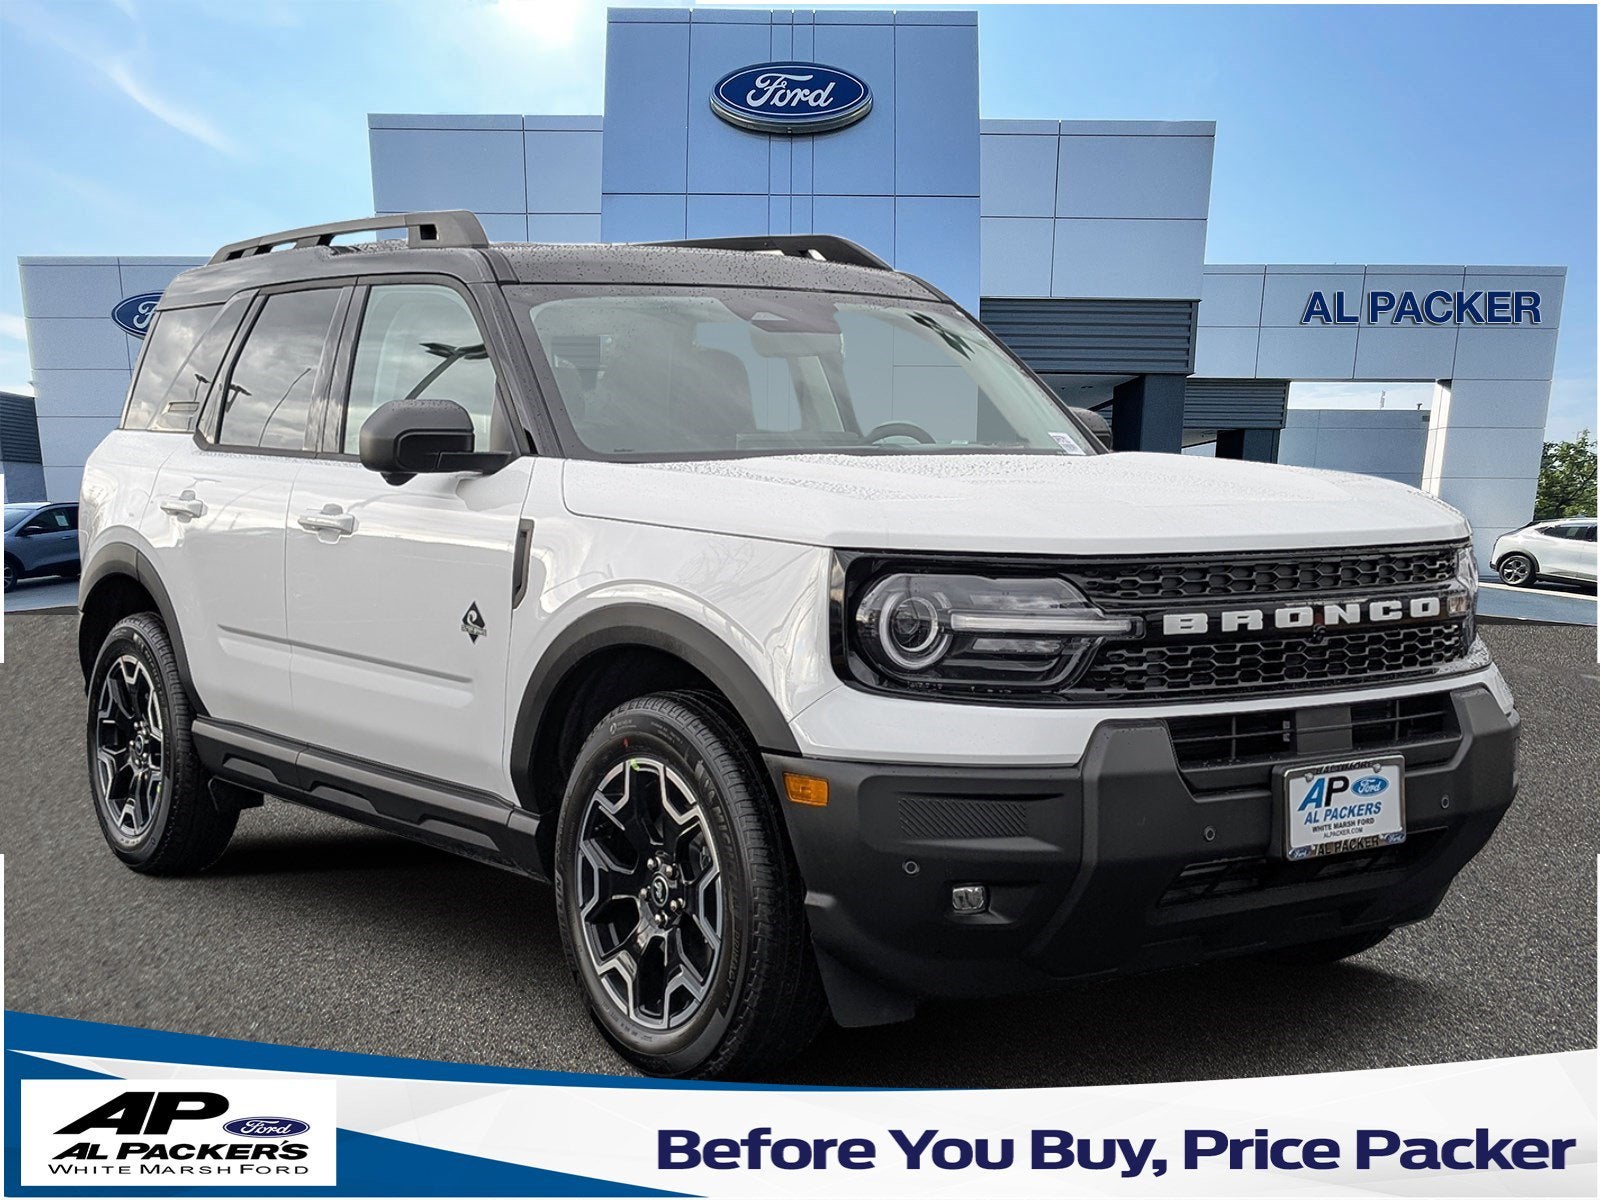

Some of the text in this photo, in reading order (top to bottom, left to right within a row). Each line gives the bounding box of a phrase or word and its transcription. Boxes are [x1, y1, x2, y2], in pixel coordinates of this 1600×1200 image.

[746, 72, 836, 108] Ford
[1302, 290, 1542, 325] AL PACKER
[1163, 597, 1440, 635] BRONCO
[1297, 775, 1350, 812] AP
[1357, 778, 1382, 793] Ford
[1304, 801, 1382, 825] AL PACKERS
[1312, 817, 1375, 833] WHITE MARSH FORD
[1334, 835, 1380, 852] PACKER
